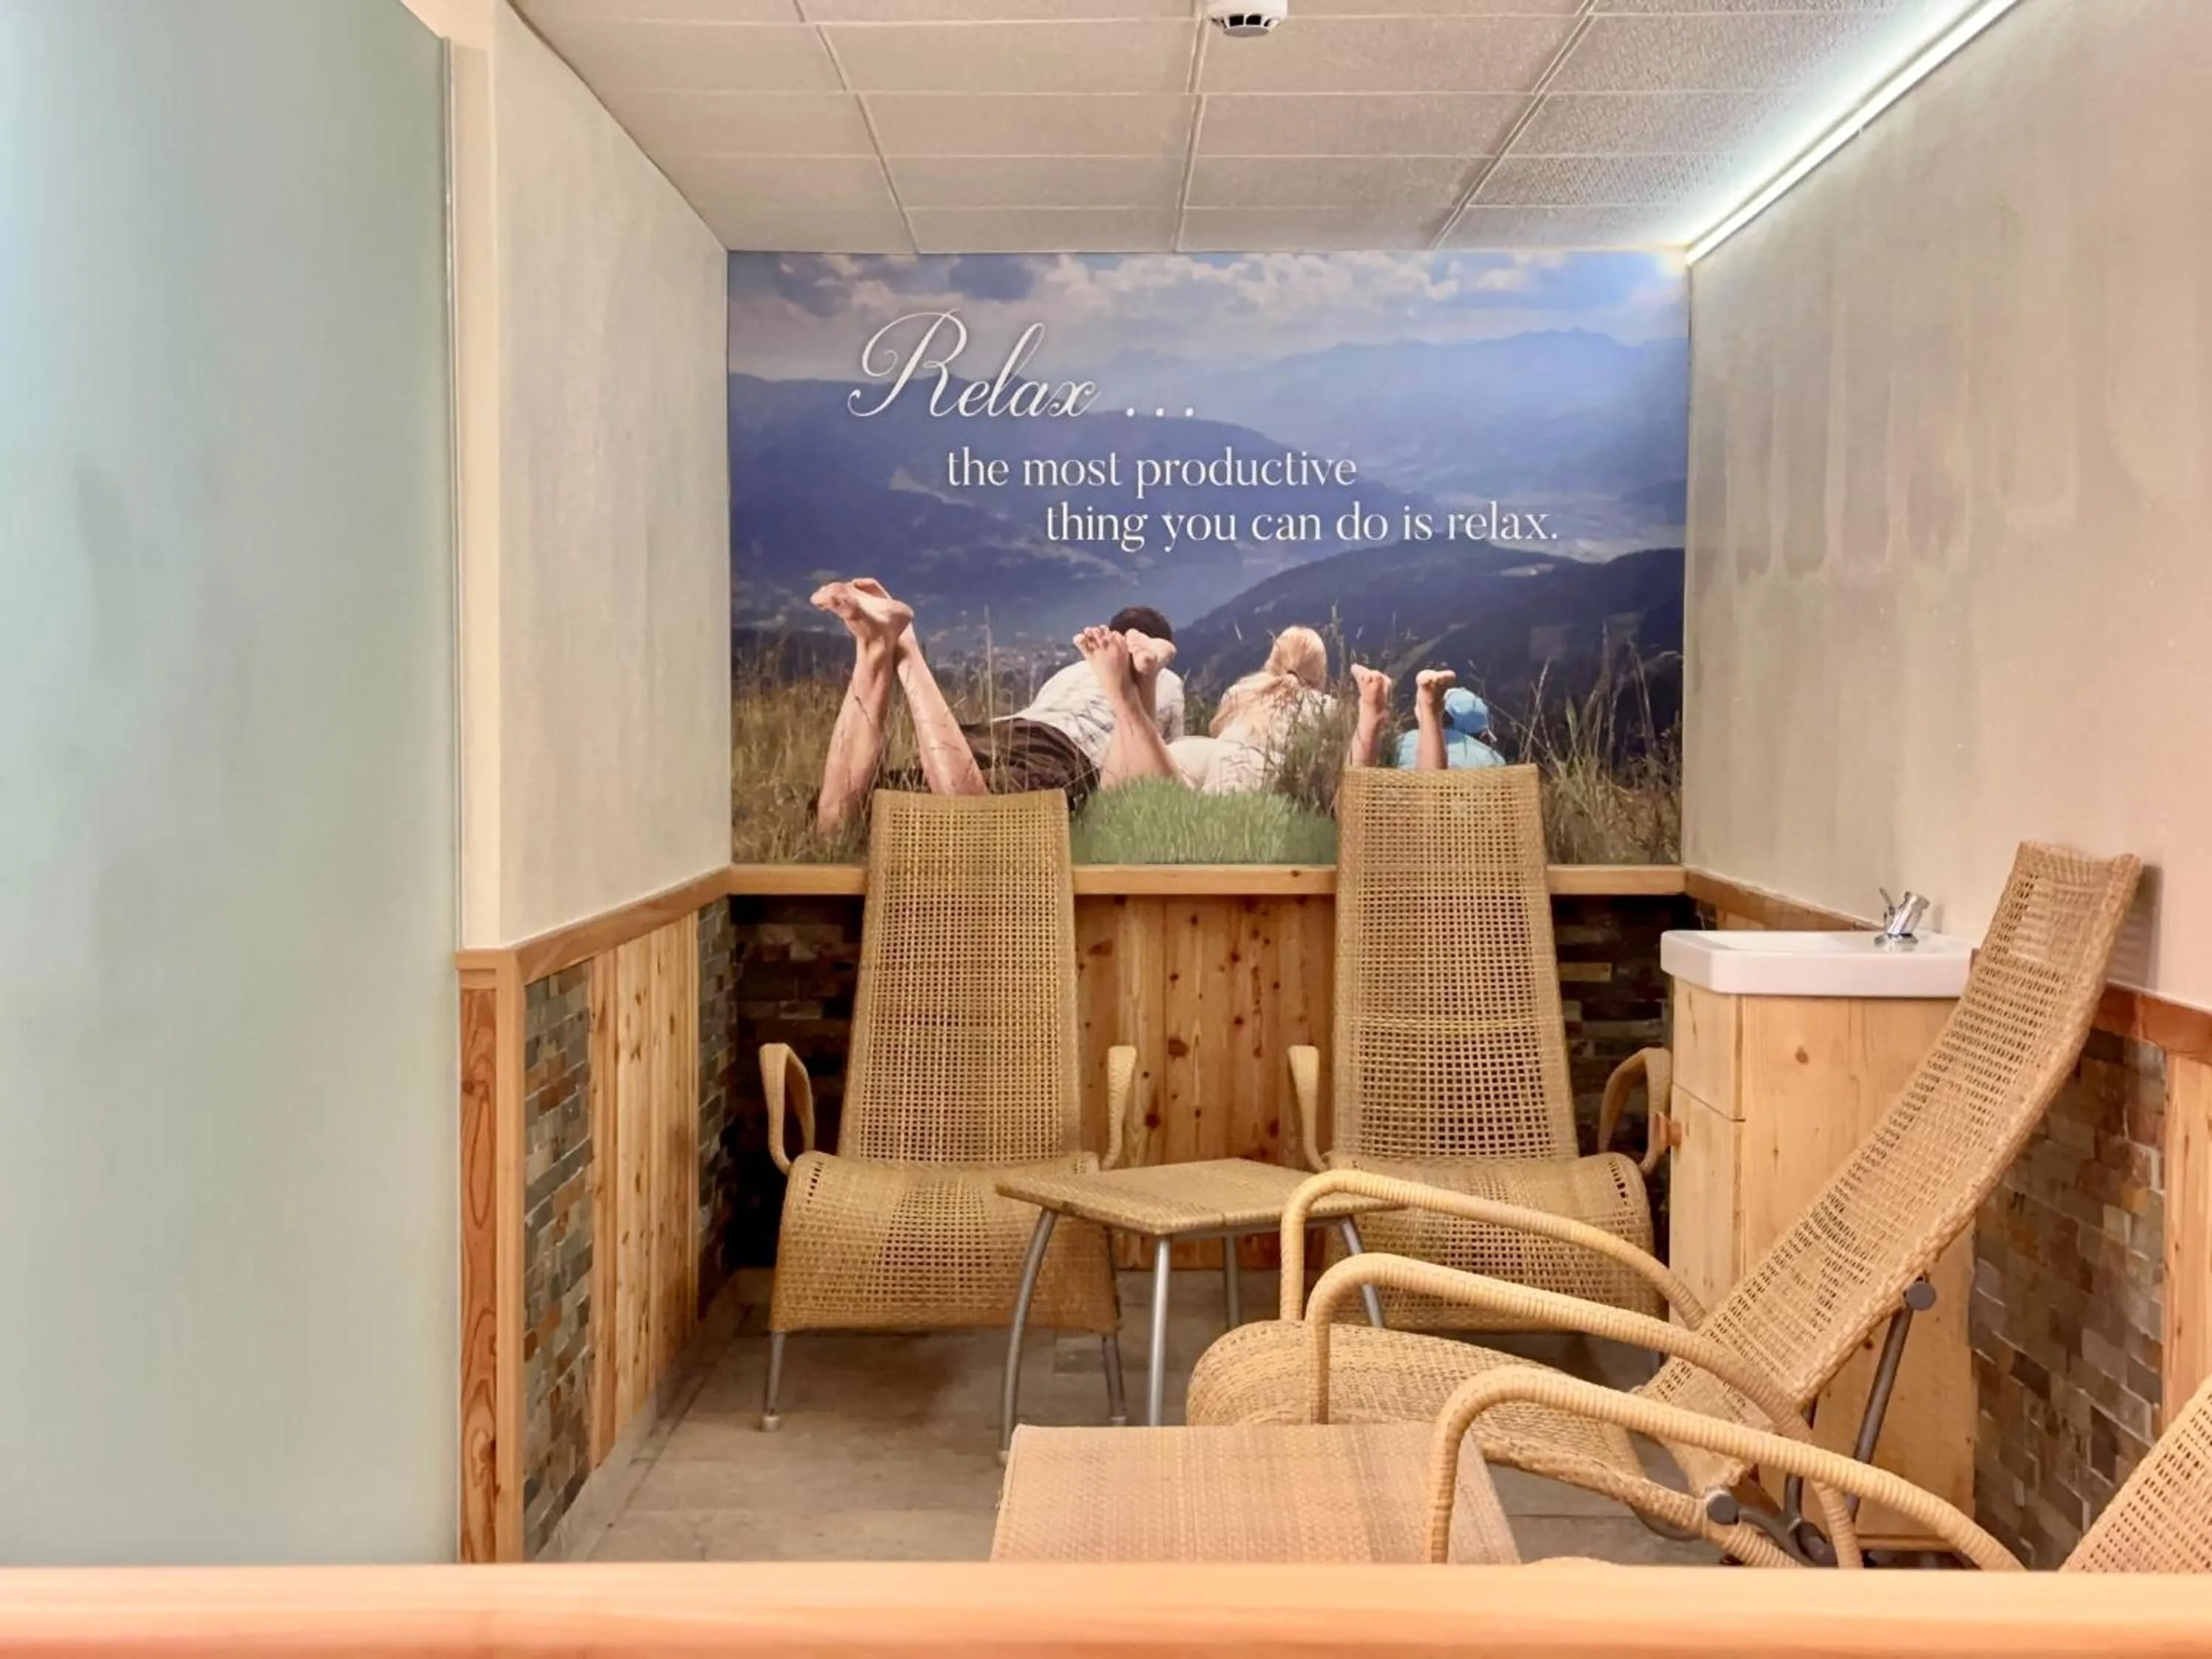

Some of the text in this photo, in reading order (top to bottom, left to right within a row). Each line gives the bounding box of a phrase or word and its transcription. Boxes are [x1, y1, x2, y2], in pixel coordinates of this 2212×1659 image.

[846, 307, 1100, 419] Relax
[947, 445, 1357, 499] the most productive
[1046, 499, 1559, 554] thing you can do is relax.
